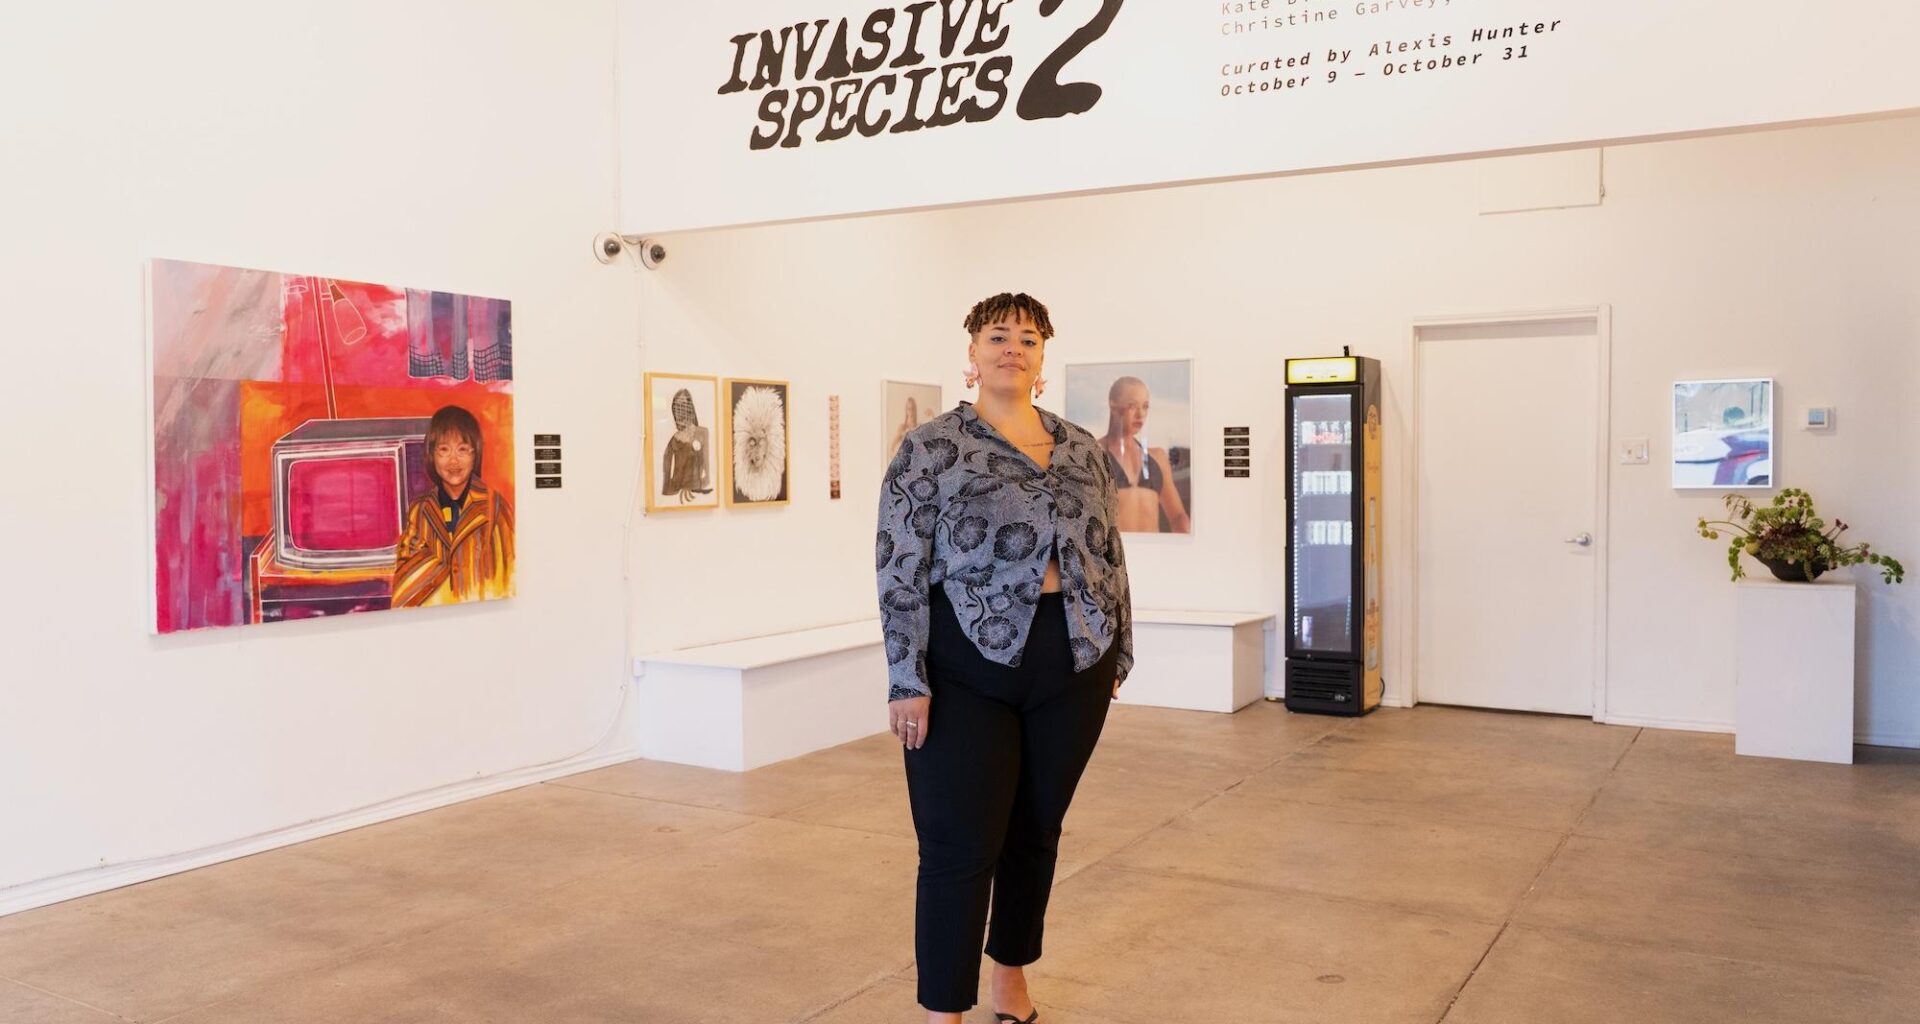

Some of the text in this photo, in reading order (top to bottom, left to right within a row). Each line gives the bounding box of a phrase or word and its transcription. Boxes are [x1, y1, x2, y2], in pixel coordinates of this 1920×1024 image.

[1221, 0, 1451, 36] Christine Garvey,
[1222, 0, 1270, 16] Kate
[717, 0, 1014, 95] INVASIVE
[1220, 75, 1311, 97] October
[1327, 70, 1338, 84] 9
[1382, 52, 1484, 77] October
[1501, 45, 1529, 61] 31
[1221, 19, 1562, 77] Curated by Alexis Hunter
[749, 0, 1124, 151] SPECIES 2
